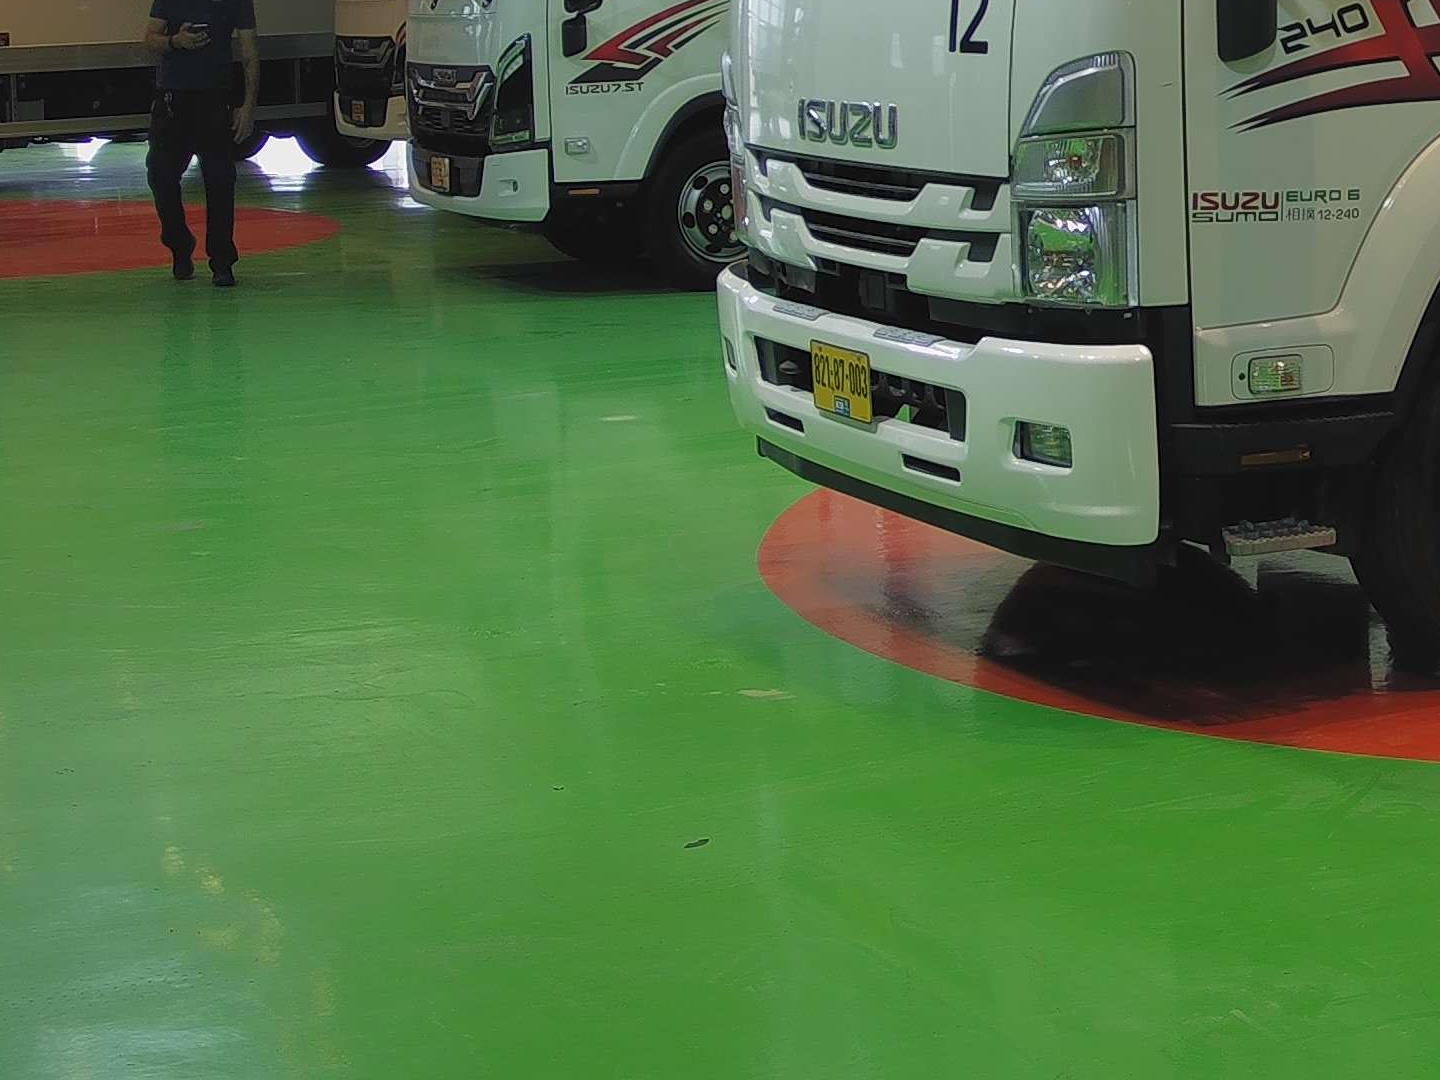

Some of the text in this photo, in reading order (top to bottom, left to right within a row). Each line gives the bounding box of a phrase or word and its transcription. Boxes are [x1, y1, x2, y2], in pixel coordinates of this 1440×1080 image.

[1277, 6, 1370, 55] 240
[798, 97, 898, 150] ISUZU
[1192, 191, 1280, 211] ISUZU
[1286, 188, 1361, 204] EURO 6
[1191, 211, 1279, 223] SUMO
[1318, 207, 1360, 221] 12-240
